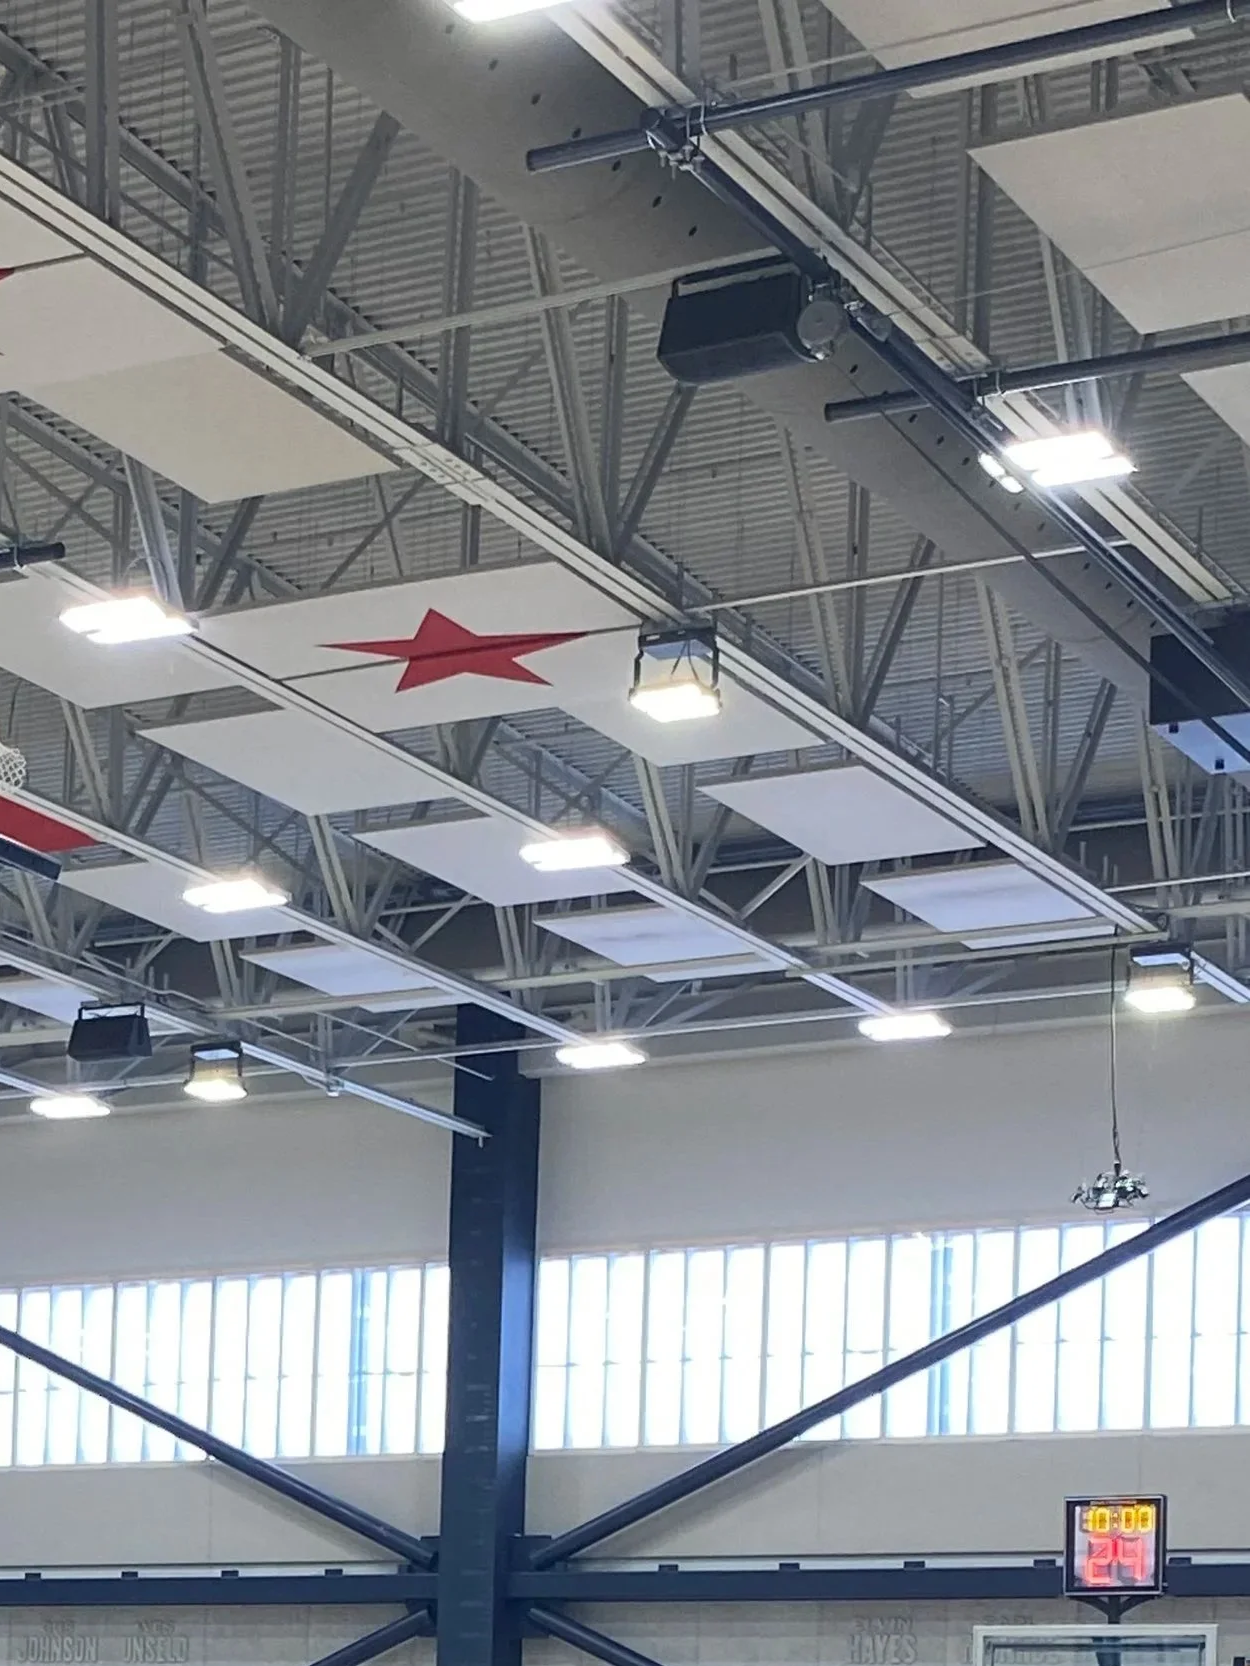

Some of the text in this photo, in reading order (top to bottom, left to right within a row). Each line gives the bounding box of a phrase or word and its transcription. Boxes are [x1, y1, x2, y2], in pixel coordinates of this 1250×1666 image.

[1085, 1536, 1144, 1584] 24
[18, 1636, 99, 1663] JOHNSON
[124, 1636, 189, 1664] UNSELD
[848, 1633, 917, 1665] HAYES
